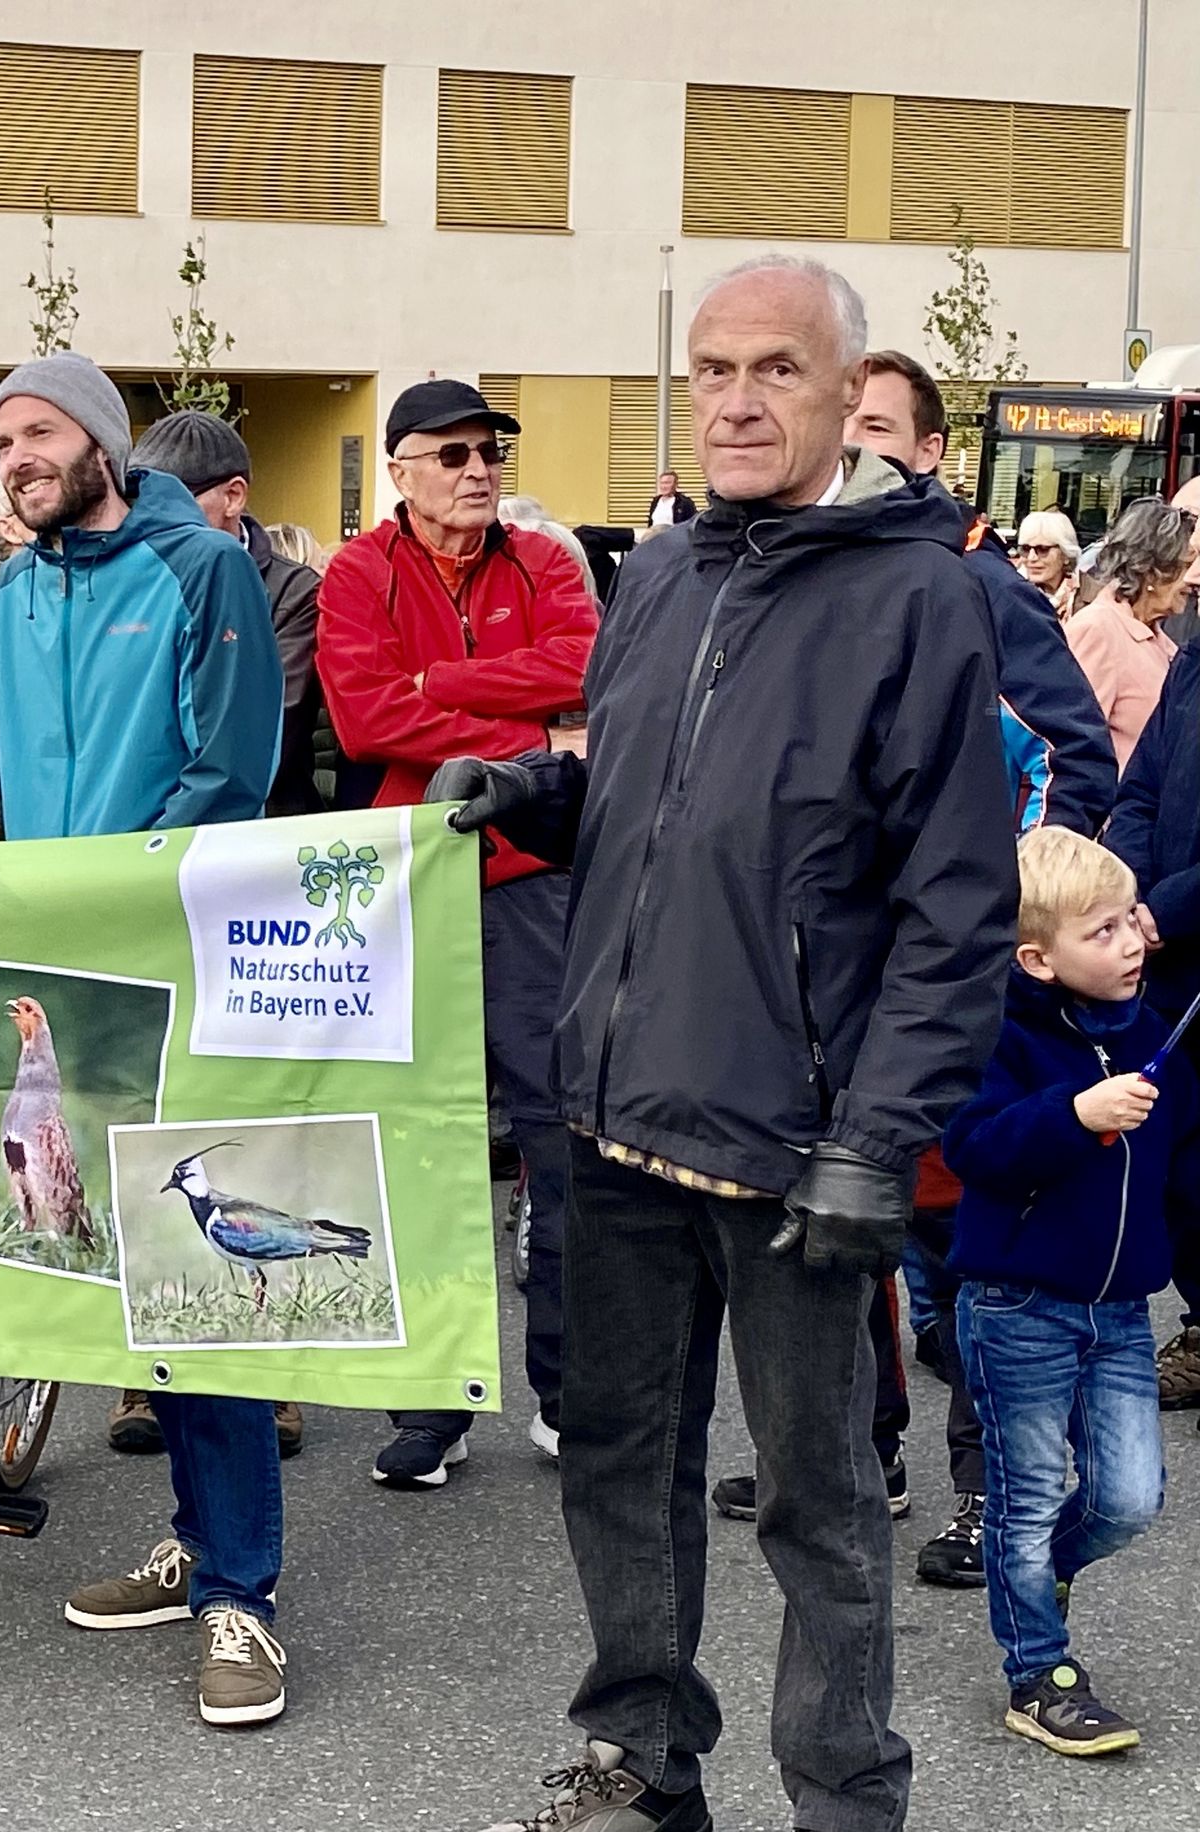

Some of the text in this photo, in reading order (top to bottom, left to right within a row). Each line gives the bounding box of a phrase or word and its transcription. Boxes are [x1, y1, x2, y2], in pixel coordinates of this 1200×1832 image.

[1006, 404, 1030, 432] 47
[228, 920, 311, 946] BUND
[230, 956, 370, 983] Naturschutz
[226, 988, 374, 1021] in Bayern e.V.
